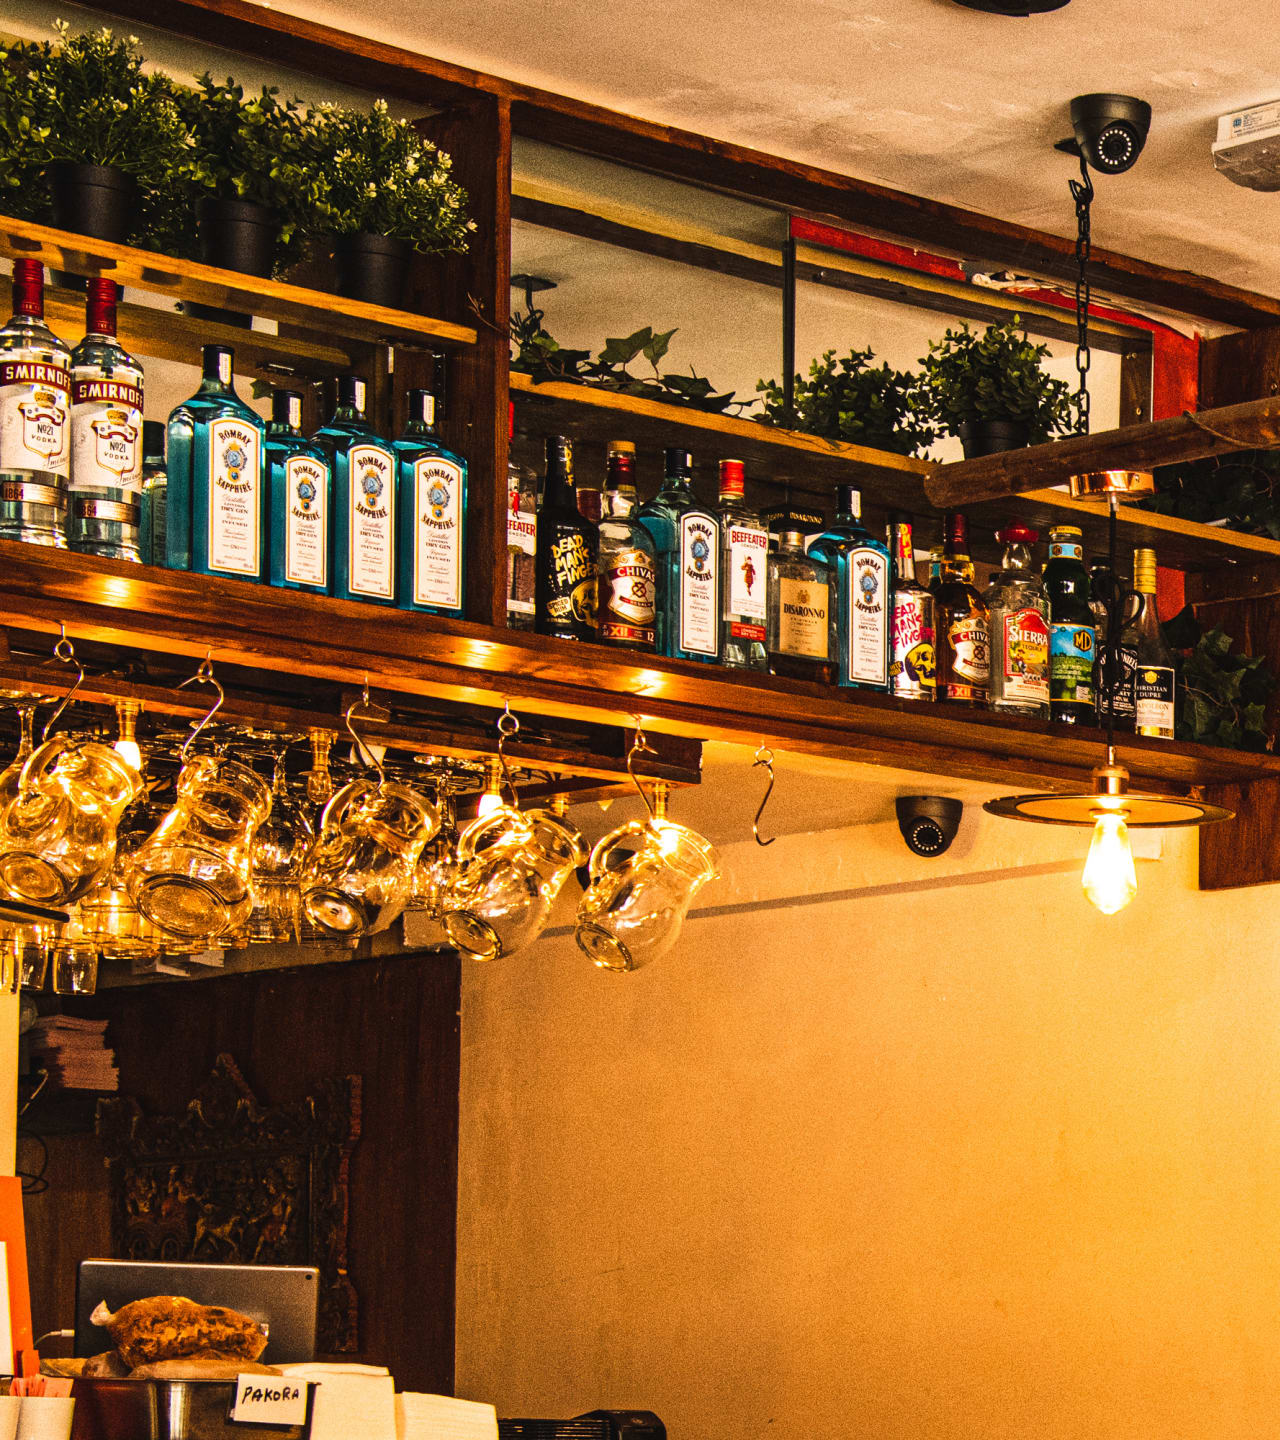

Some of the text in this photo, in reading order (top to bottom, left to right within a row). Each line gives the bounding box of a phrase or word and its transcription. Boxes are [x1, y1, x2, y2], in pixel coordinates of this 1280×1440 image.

[79, 384, 143, 407] SMIRNOFF
[31, 434, 57, 444] VODKA
[218, 429, 253, 448] BOMBAY
[103, 452, 129, 461] VODKA
[357, 456, 388, 474] BOMBAY
[293, 465, 321, 482] BOMBAY
[423, 468, 455, 486] BOMBAY
[216, 475, 253, 494] SAPPHIRE
[82, 504, 97, 517] 864
[291, 505, 322, 522] SAPPHIRE
[355, 501, 389, 519] SAPPHIRE
[421, 513, 457, 531] SAPPHIRE
[687, 523, 713, 540] BOMBAY
[731, 530, 767, 549] BEEFEATER
[551, 535, 584, 558] DEAD
[686, 565, 714, 582] SAPPHIRE
[856, 557, 882, 574] BOMBAY
[616, 566, 656, 584] CHIVAS
[783, 603, 826, 620] DISARONNO
[854, 600, 882, 614] SAPPHIRE
[894, 602, 916, 619] EAD
[610, 626, 629, 637] XII
[647, 631, 655, 642] 12
[1008, 625, 1049, 646] SIERRA
[1136, 685, 1168, 693] HRISTIAN
[241, 1386, 300, 1405] PAKORA
